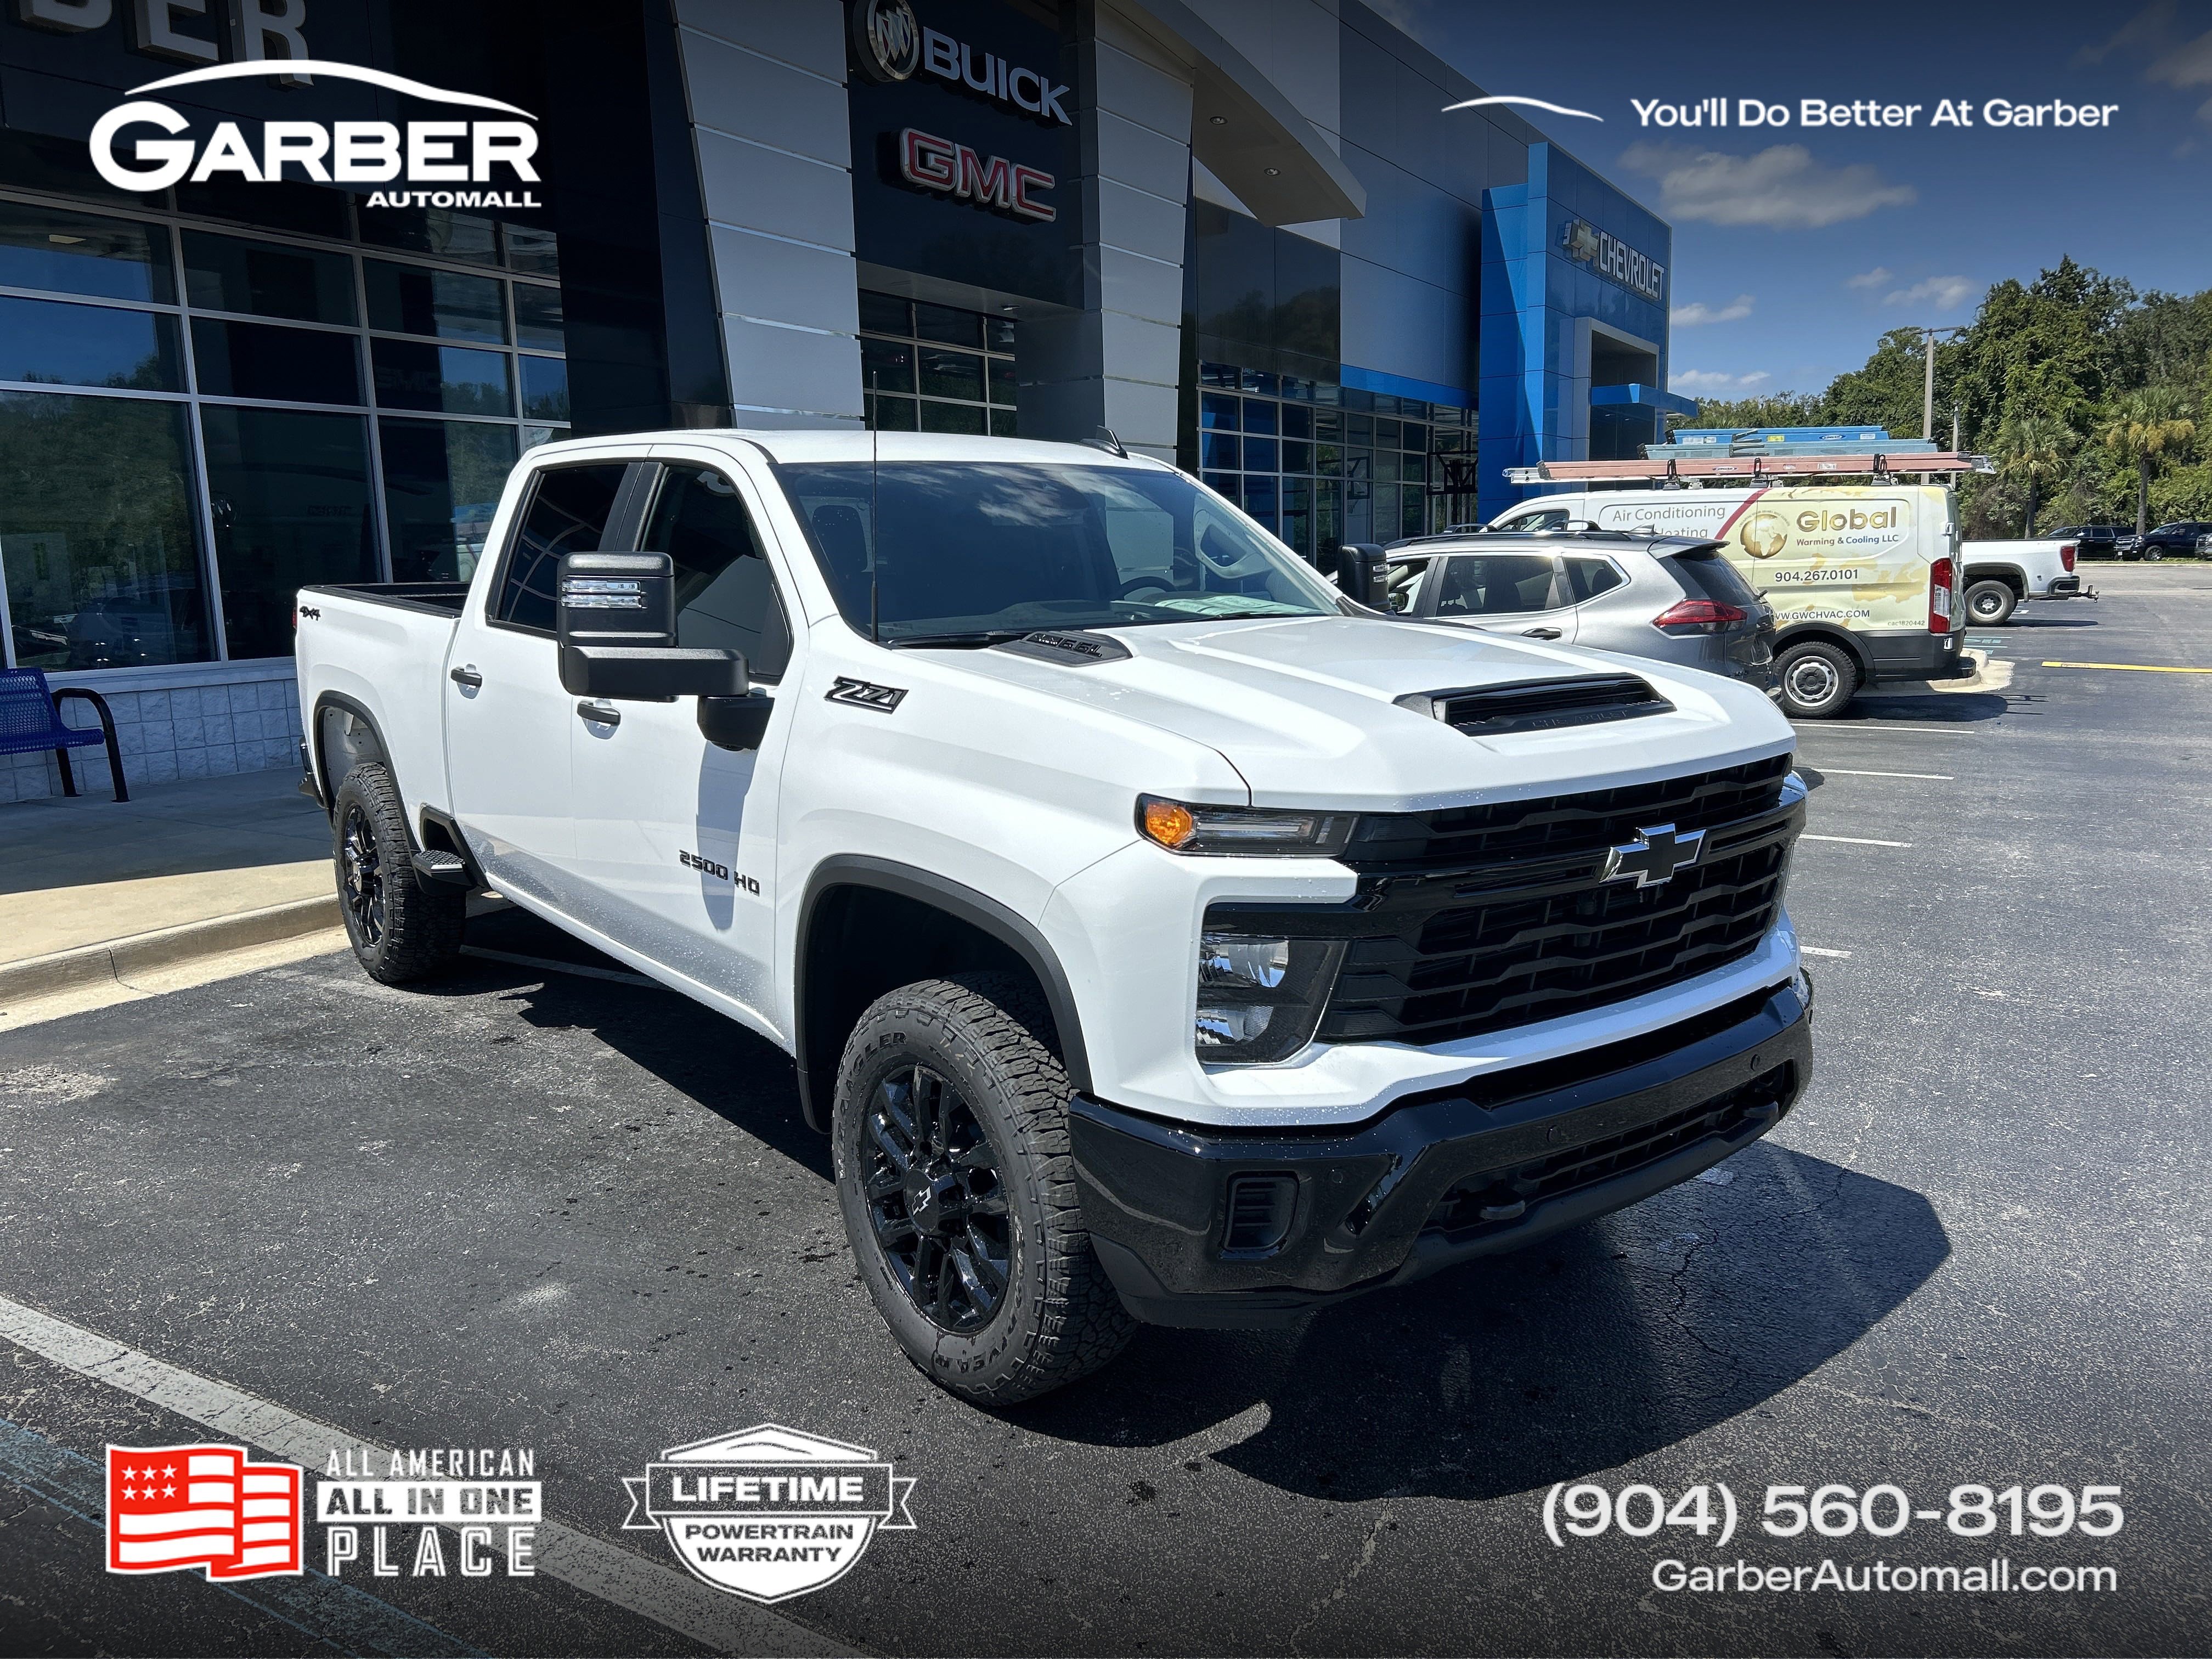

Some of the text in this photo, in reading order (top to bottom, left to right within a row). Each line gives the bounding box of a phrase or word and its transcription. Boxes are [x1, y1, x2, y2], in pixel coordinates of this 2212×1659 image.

[923, 26, 1072, 126] BUICK
[900, 127, 1056, 222] GMC
[1599, 230, 1664, 301] CHEVROLET
[1613, 510, 1632, 521] Air
[1635, 505, 1725, 521] Conditioning
[1797, 506, 1897, 532] Global
[1797, 538, 1835, 546] Warming
[1846, 535, 1880, 544] Cooling
[1882, 534, 1899, 543] LLC
[1775, 569, 1858, 582] 904.267.0101
[823, 675, 909, 714] Z71
[679, 849, 760, 897] 2500 HD
